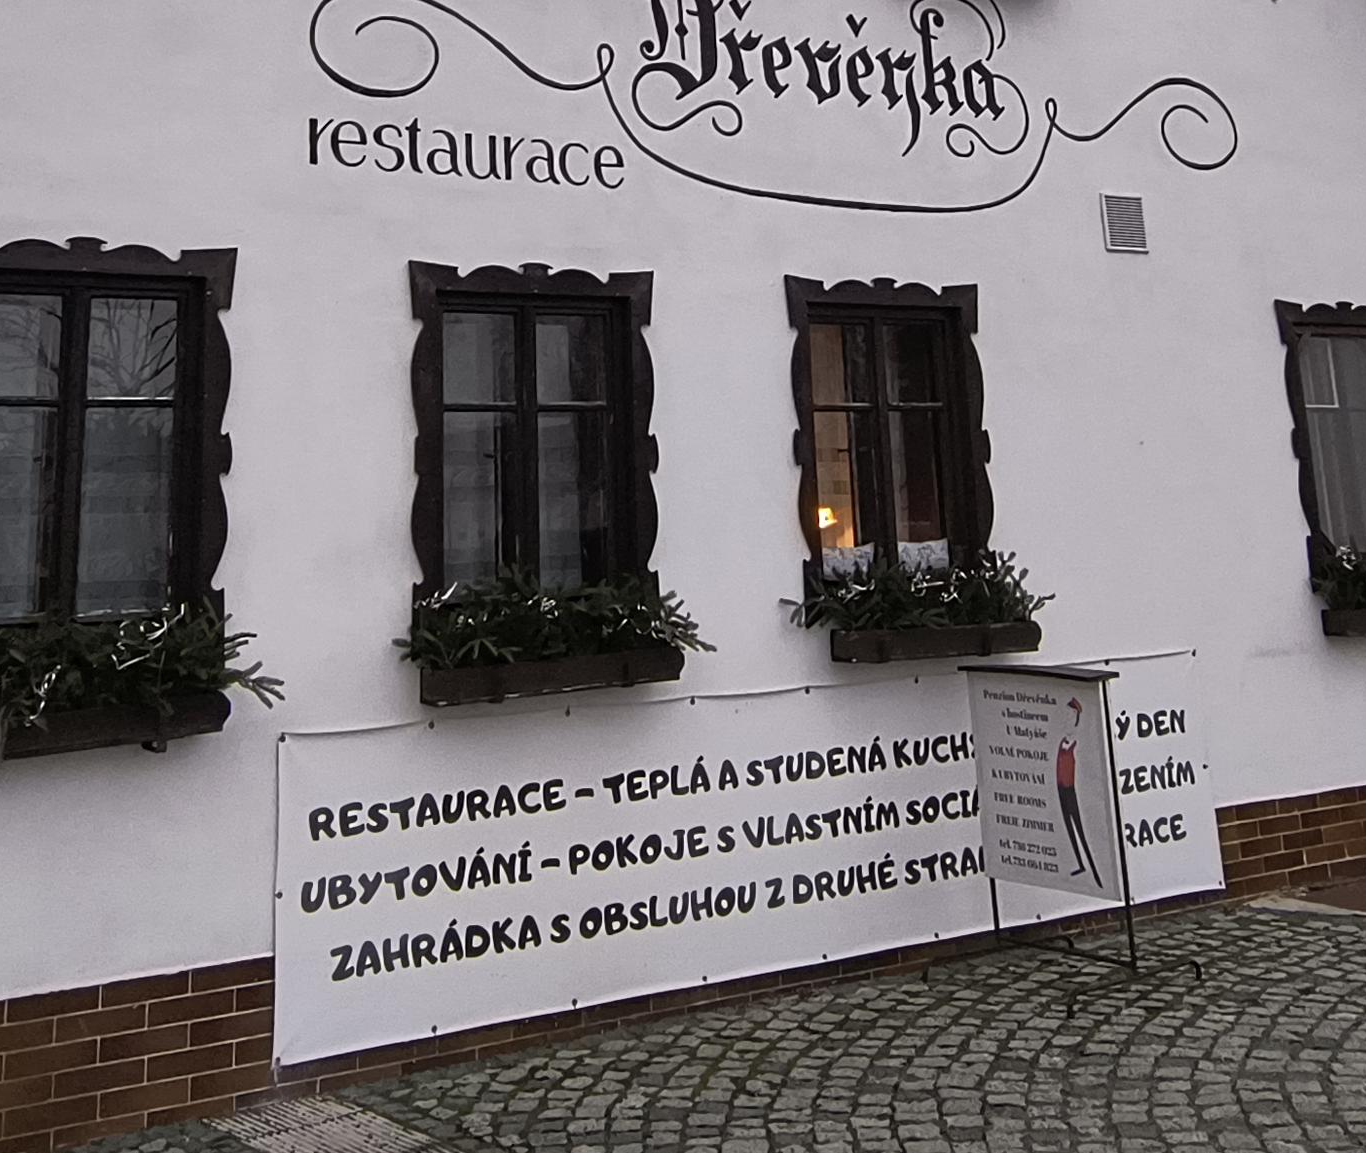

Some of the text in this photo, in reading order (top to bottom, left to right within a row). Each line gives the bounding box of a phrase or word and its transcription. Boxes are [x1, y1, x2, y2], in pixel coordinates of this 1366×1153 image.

[308, 116, 624, 189] restaurace
[300, 840, 533, 914] UBYTOVÁNÍ
[569, 825, 710, 876] POKOJE
[716, 825, 736, 853] S
[742, 795, 900, 849] VLASTNÍM
[1118, 755, 1196, 795] ZENÍM
[308, 778, 567, 841] RESTAURACE
[602, 755, 711, 804] TEPLÁ
[718, 759, 739, 790] A
[746, 735, 887, 787] STUDENÁ
[1137, 709, 1186, 738] DEN
[329, 915, 542, 982] ZAHRÁDKA
[550, 914, 572, 944] S
[579, 881, 757, 940] OBSLUHOU
[765, 877, 786, 909] Z
[792, 852, 898, 905] DRUHÉ
[1124, 813, 1187, 849] RACE
